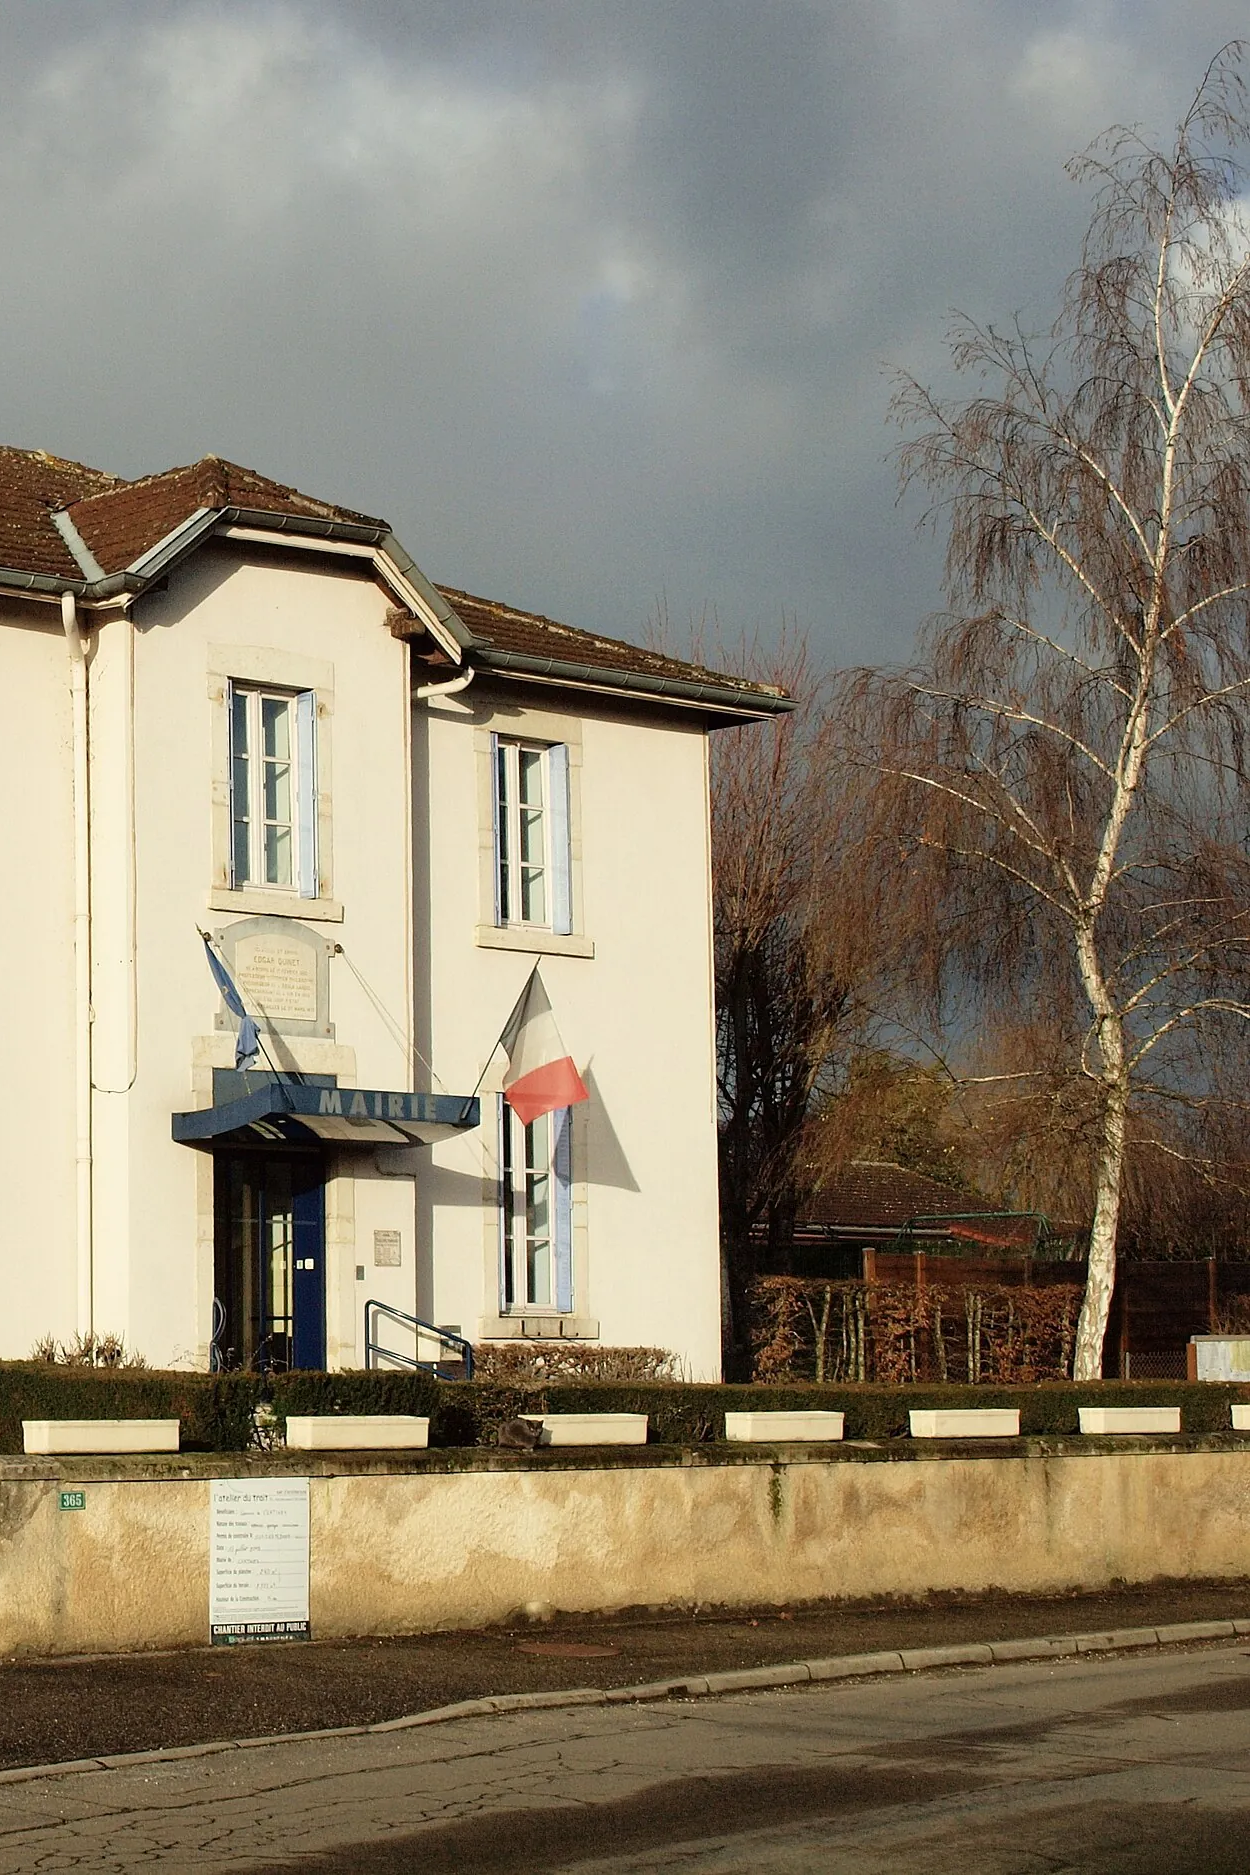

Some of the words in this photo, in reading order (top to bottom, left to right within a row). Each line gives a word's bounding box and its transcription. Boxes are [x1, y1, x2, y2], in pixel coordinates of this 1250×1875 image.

[253, 955, 275, 965] EDGAR
[318, 1089, 437, 1120] MAIRIE
[63, 1494, 82, 1507] 365
[243, 1493, 251, 1502] du
[213, 1624, 246, 1634] CHANTIER
[246, 1623, 275, 1633] INTERDIT
[276, 1622, 285, 1632] AU
[286, 1621, 307, 1631] PUBLIC
